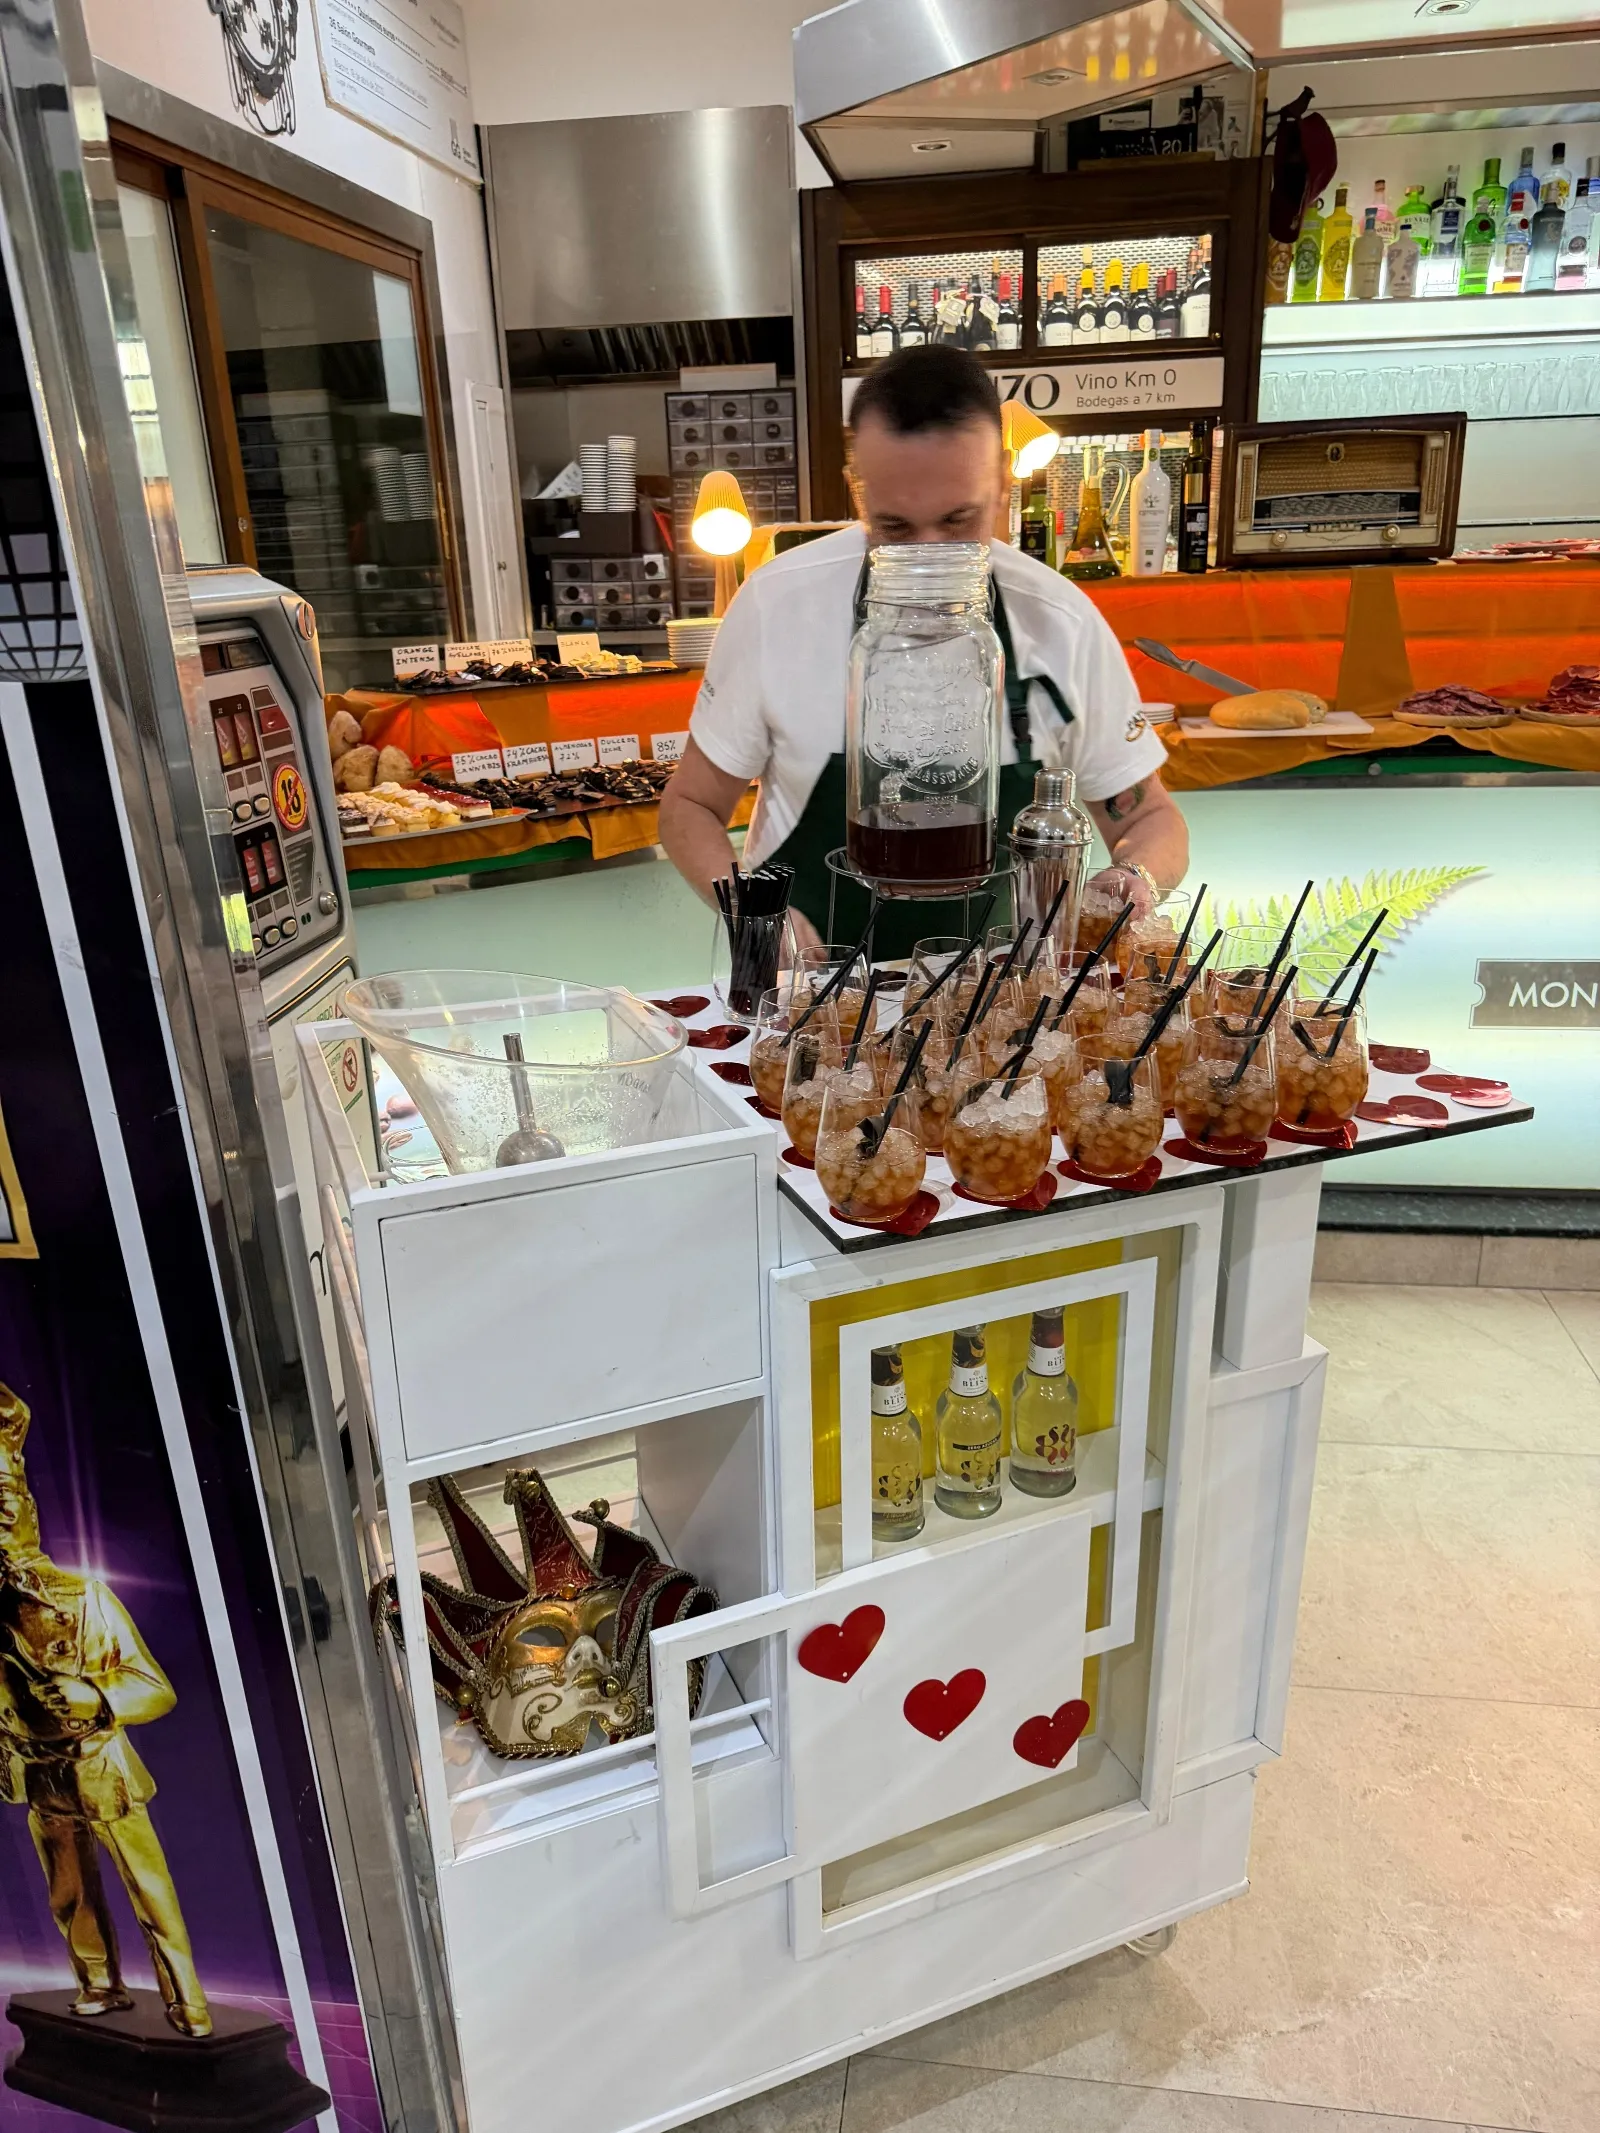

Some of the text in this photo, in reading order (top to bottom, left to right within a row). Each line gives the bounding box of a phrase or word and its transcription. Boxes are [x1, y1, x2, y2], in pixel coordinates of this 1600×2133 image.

[1075, 373, 1118, 390] Vino
[1125, 370, 1156, 388] Km
[1076, 391, 1176, 409] Bodegas a 7 km
[397, 646, 434, 655] ORANGE
[395, 656, 435, 666] INTENSO
[600, 738, 626, 746] DULCE
[656, 740, 676, 753] 85%
[525, 746, 547, 755] CACAO
[475, 754, 498, 762] CACAO
[455, 763, 501, 775] CANNABIS
[1508, 981, 1599, 1008] MON
